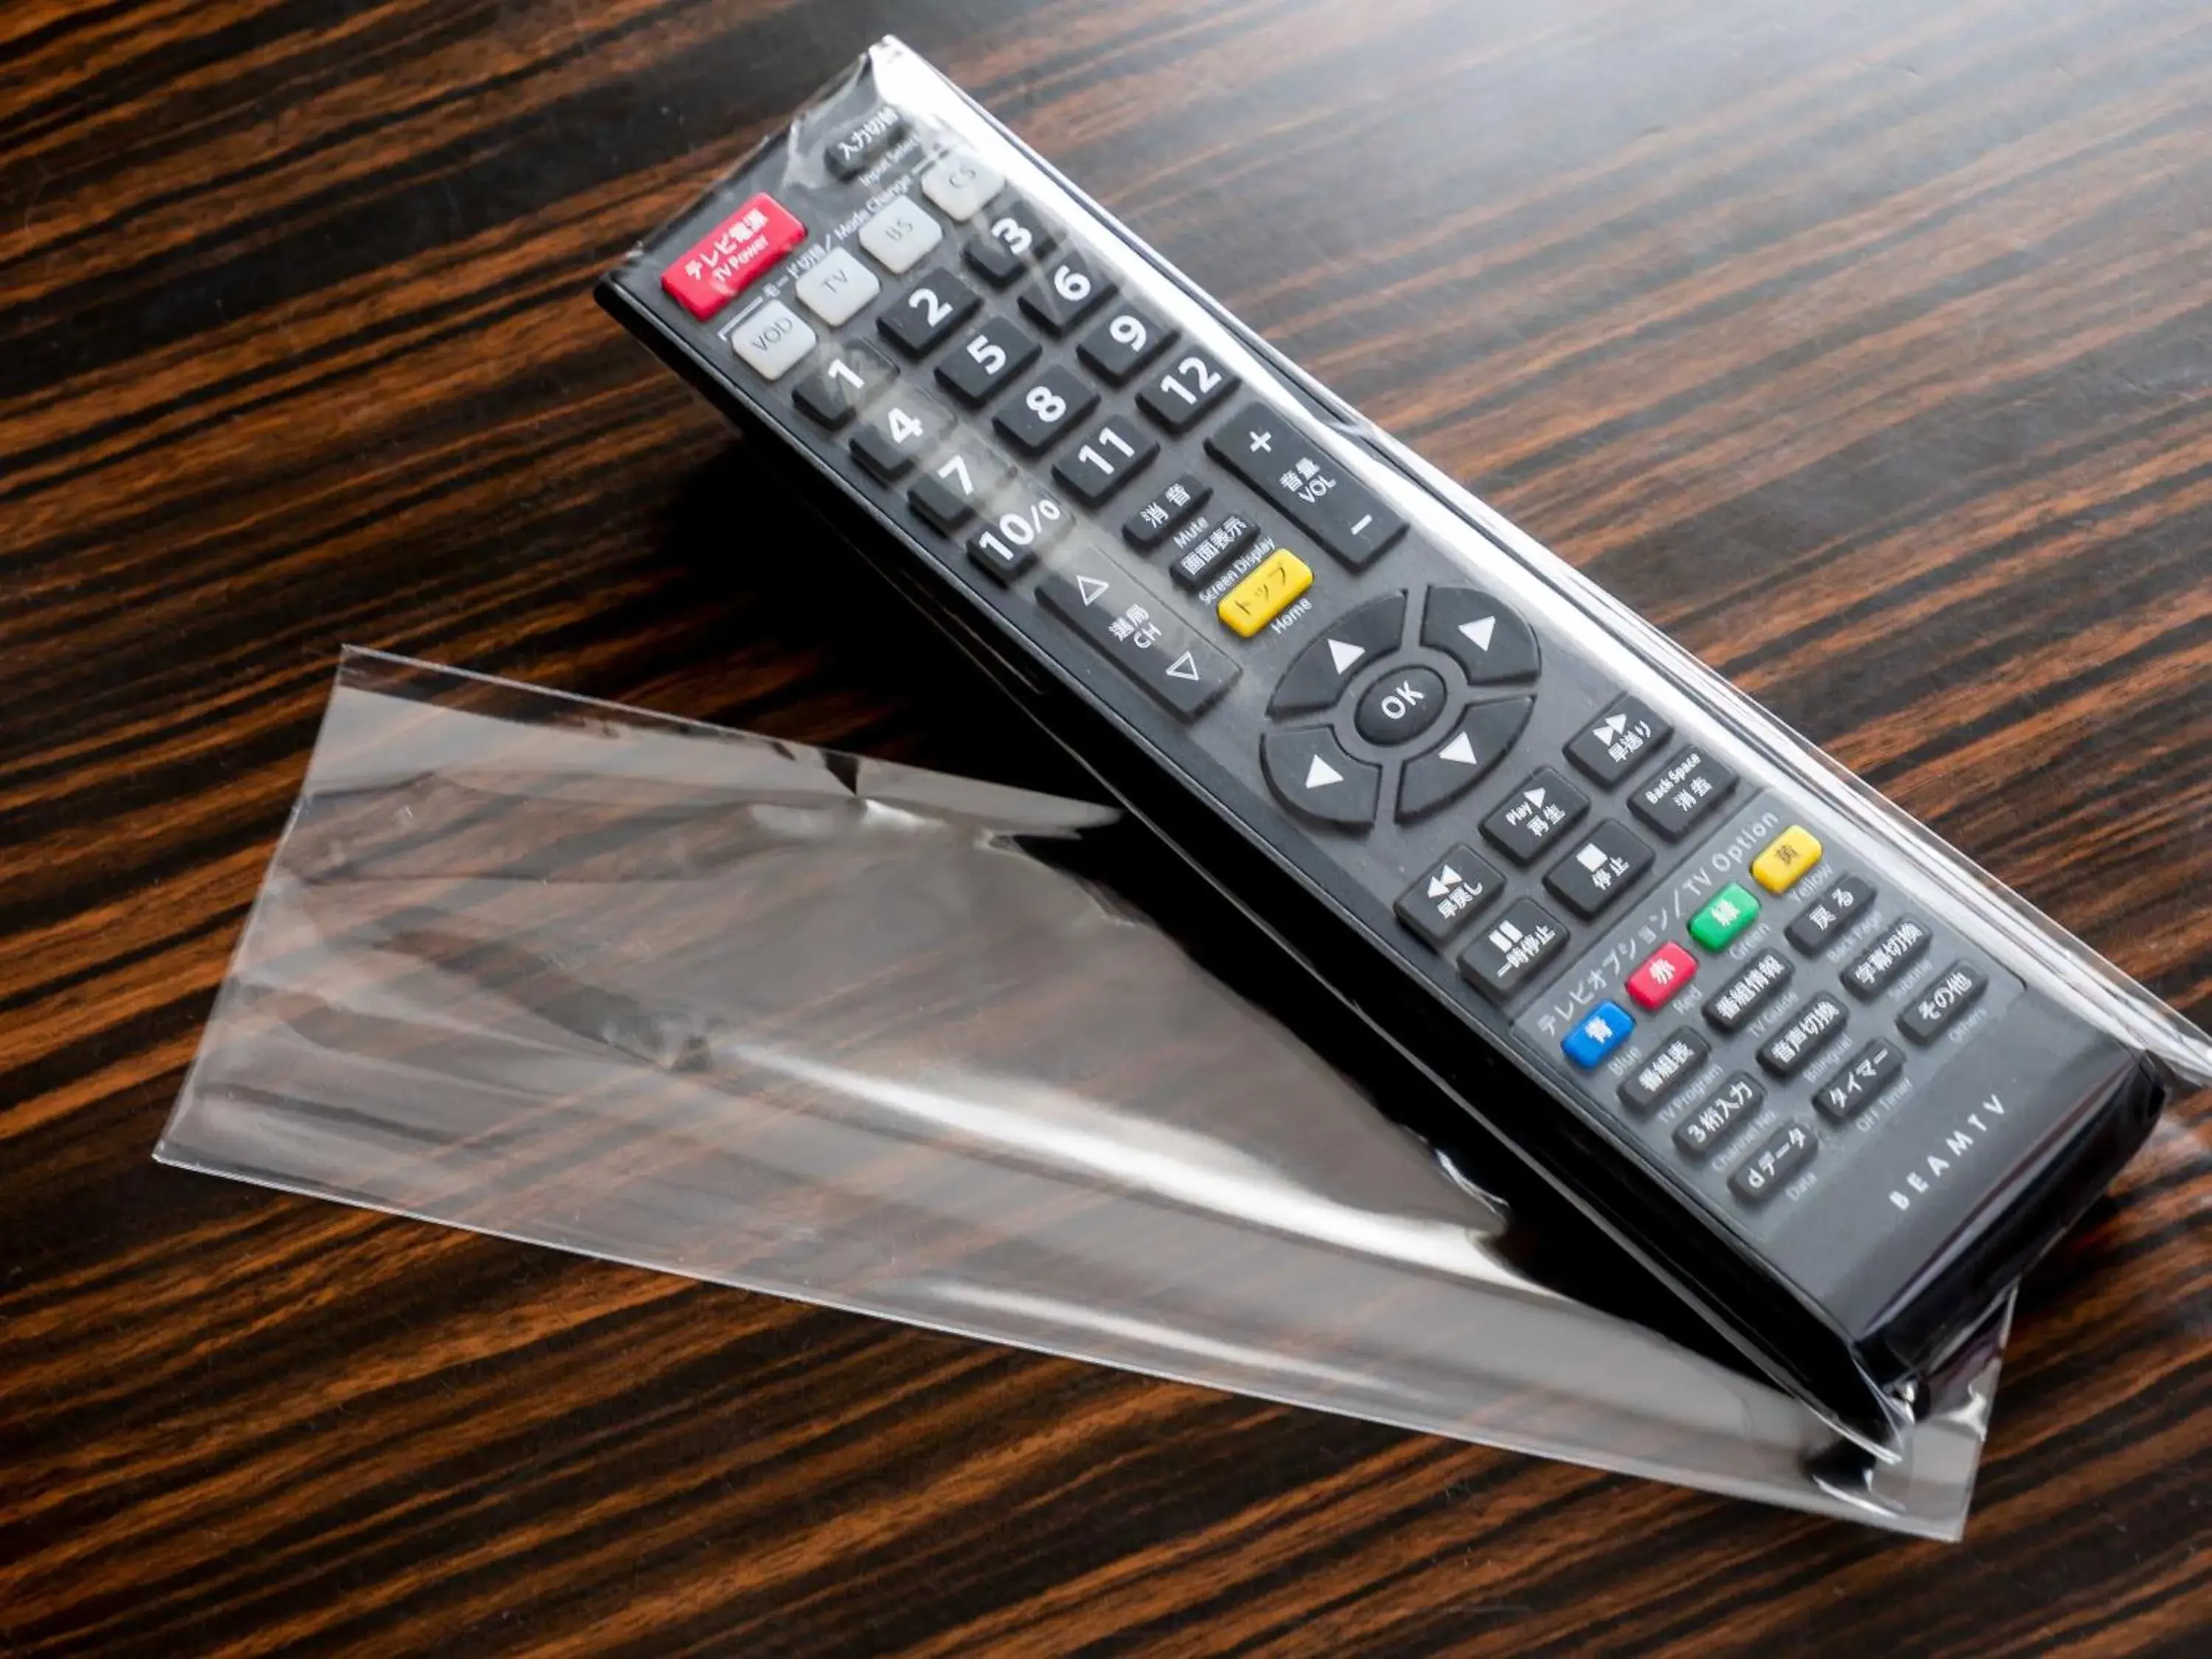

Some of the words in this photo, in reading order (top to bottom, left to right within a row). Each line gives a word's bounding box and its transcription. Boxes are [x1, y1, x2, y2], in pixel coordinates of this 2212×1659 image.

[948, 167, 977, 188] CS
[685, 209, 768, 280] テレビ電源
[991, 218, 1032, 255] 3
[712, 263, 732, 287] TV
[728, 234, 768, 269] Power
[822, 269, 848, 293] TV
[1054, 265, 1091, 301] 6
[908, 288, 953, 327] 2
[751, 318, 793, 352] VOD
[1110, 315, 1147, 352] 9
[828, 358, 865, 389] 1
[967, 335, 1006, 375] 5
[1161, 357, 1222, 405] 12
[1026, 386, 1066, 422] 8
[888, 407, 923, 443] 4
[1079, 428, 1135, 475] 11
[938, 456, 974, 495] 7
[1279, 458, 1320, 492] 音量
[1298, 476, 1336, 503] VOL
[1174, 517, 1208, 549] Mute
[1180, 517, 1247, 575] 画面表示
[1198, 570, 1239, 605] Screen
[1234, 537, 1276, 574] Display
[1108, 603, 1150, 641] 選局
[1133, 623, 1162, 648] CH
[1270, 598, 1312, 635] Home
[1381, 681, 1425, 719] OK
[1608, 720, 1651, 762] 早送り
[1645, 778, 1674, 804] Back
[1668, 753, 1701, 784] Space
[1506, 801, 1533, 826] Play
[1527, 804, 1565, 837] 再生
[1712, 813, 1778, 872] Option
[1592, 857, 1630, 890] 停止
[1789, 862, 1834, 904] Yellow
[1438, 882, 1483, 919] 早戻し
[1809, 888, 1854, 930] 戻る
[1497, 925, 1556, 978] 一時停止
[1730, 922, 1771, 960] Green
[1649, 959, 1675, 984] 赤
[1717, 955, 1785, 1019] 番組情報
[1673, 984, 1703, 1014] Red
[1748, 1020, 1766, 1037] TV
[1763, 992, 1799, 1023] Guide
[1919, 972, 1972, 1019] その他
[1949, 1008, 1988, 1042] Others
[1608, 1046, 1642, 1077] Blue
[1639, 1040, 1694, 1091] 番組表
[1804, 1034, 1853, 1083] Bilingual
[1658, 1102, 1679, 1124] TV
[1673, 1064, 1724, 1110] Program
[1829, 1048, 1888, 1108] タイマー
[1879, 1077, 1913, 1110] Timer
[1711, 1125, 1761, 1172] Channel
[1748, 1127, 1806, 1188] dデータ
[1787, 1172, 1818, 1201] Data
